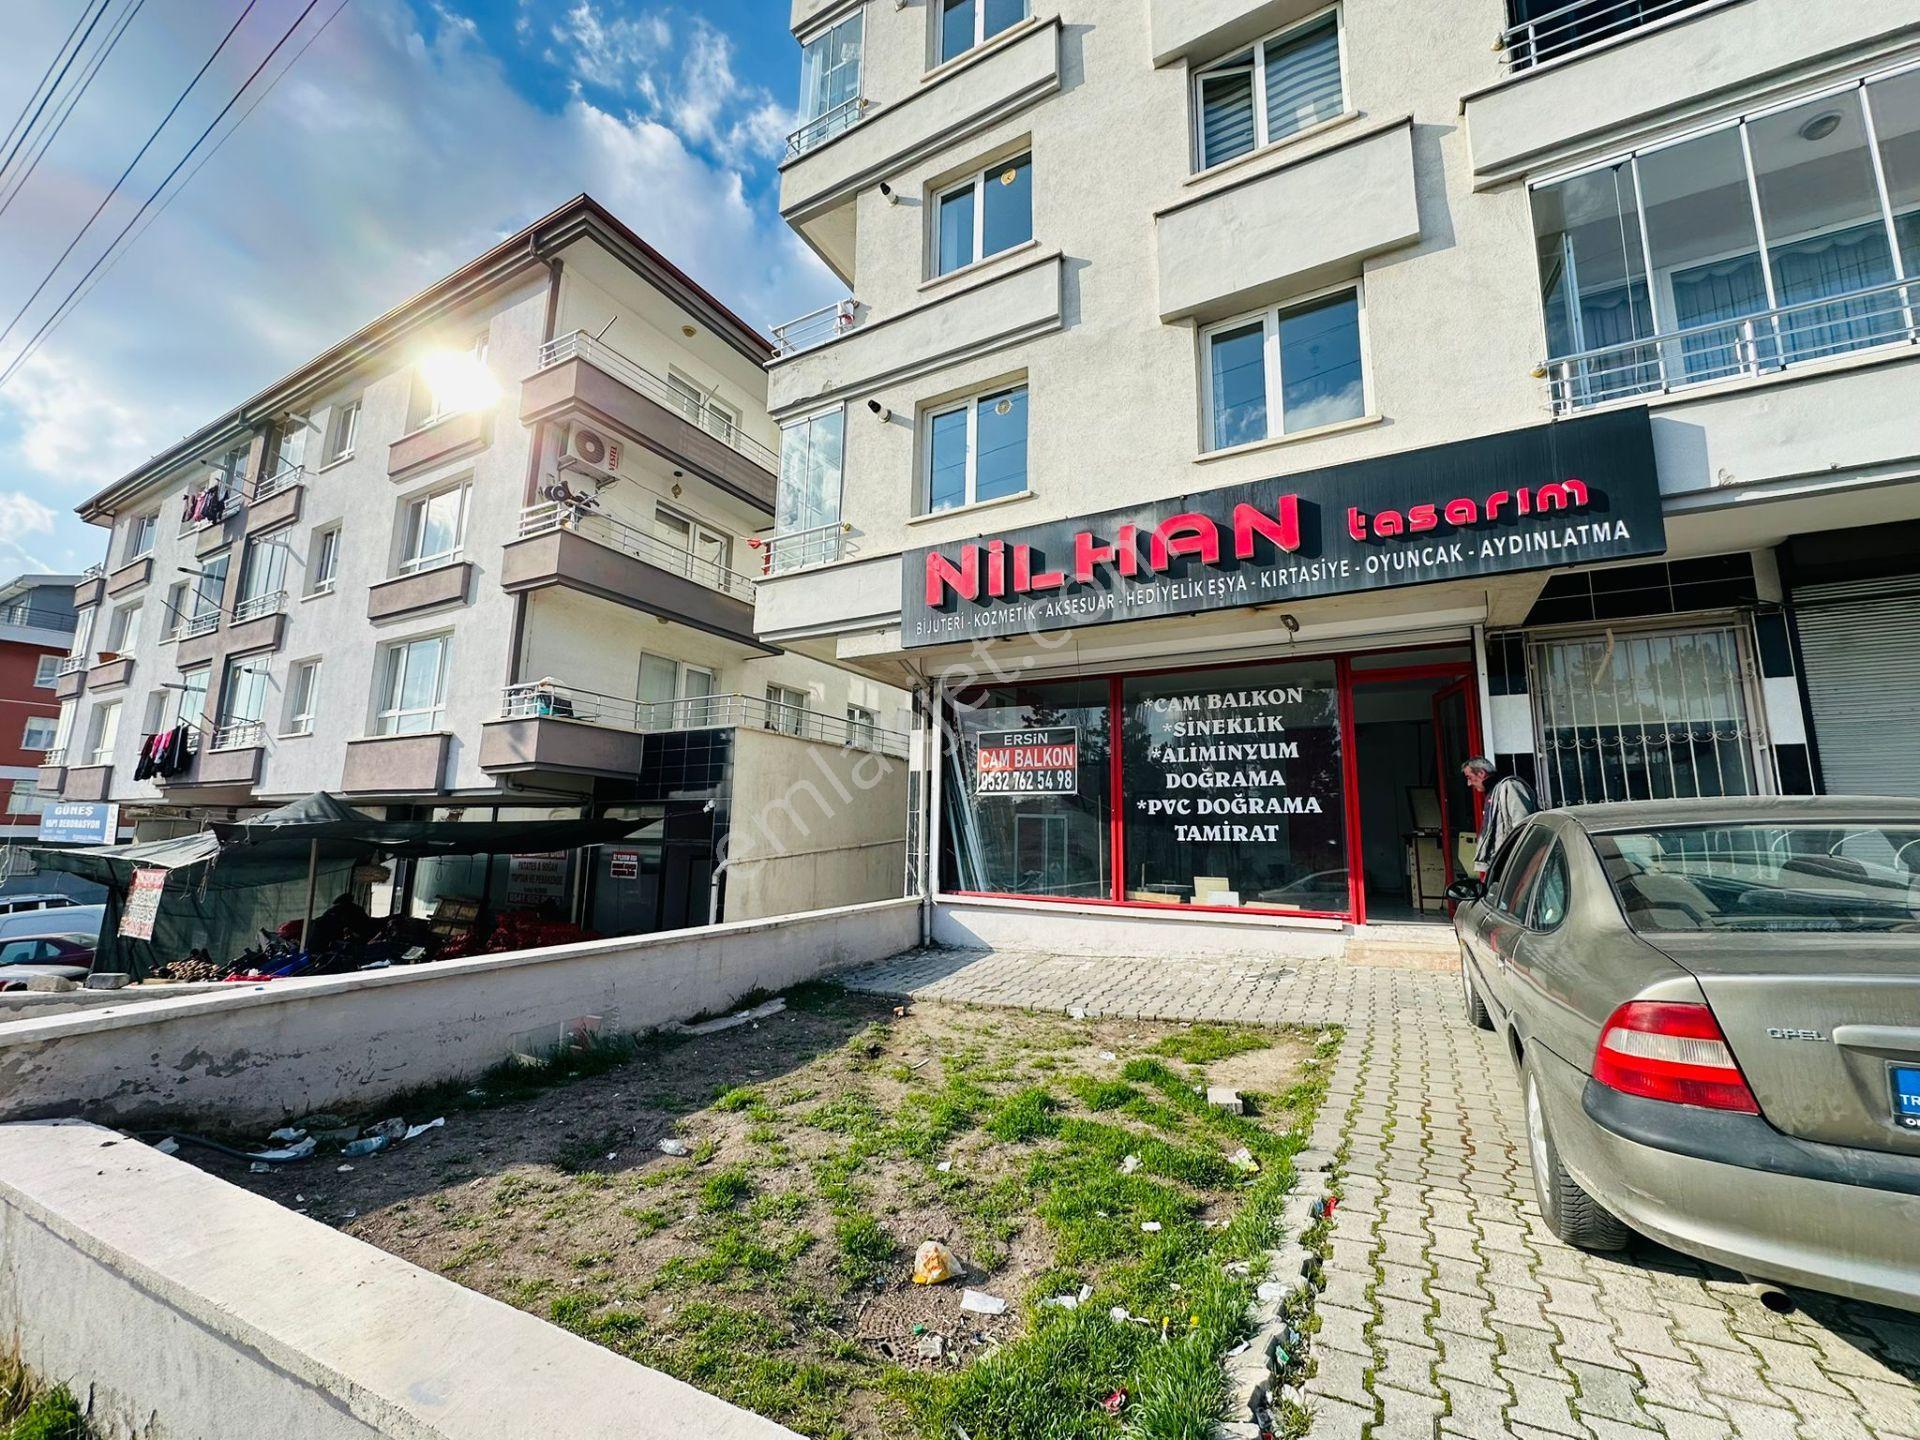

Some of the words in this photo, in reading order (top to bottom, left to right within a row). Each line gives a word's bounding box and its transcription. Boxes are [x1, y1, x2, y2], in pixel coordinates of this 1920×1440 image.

[926, 493, 1300, 607] NİLHAN
[1348, 478, 1590, 542] tasarım
[916, 610, 965, 636] BİJUTERİ
[973, 601, 1036, 628] KOZMETİK
[1046, 591, 1115, 619] AKSESUAR
[1126, 577, 1204, 607] HEDİYELİK
[1208, 574, 1248, 601] EŞYA
[1261, 557, 1350, 589] KIRTASİYE
[1367, 543, 1462, 575] OYUNCAK
[1480, 519, 1631, 560] AYDINLATMA
[1207, 687, 1303, 710] BALKON
[981, 750, 1009, 769] CAM
[1014, 747, 1073, 768] BALKON
[981, 772, 1009, 791] 0532
[1013, 771, 1033, 790] 762
[1037, 770, 1053, 790] 54
[1057, 769, 1072, 790] 98
[1165, 768, 1286, 789] DOĞRAMA
[1197, 793, 1322, 815] DOĞRAMA
[1174, 821, 1279, 842] TAMİRAT
[1766, 1028, 1829, 1042] OPEL
[1900, 1093, 1920, 1108] TR
